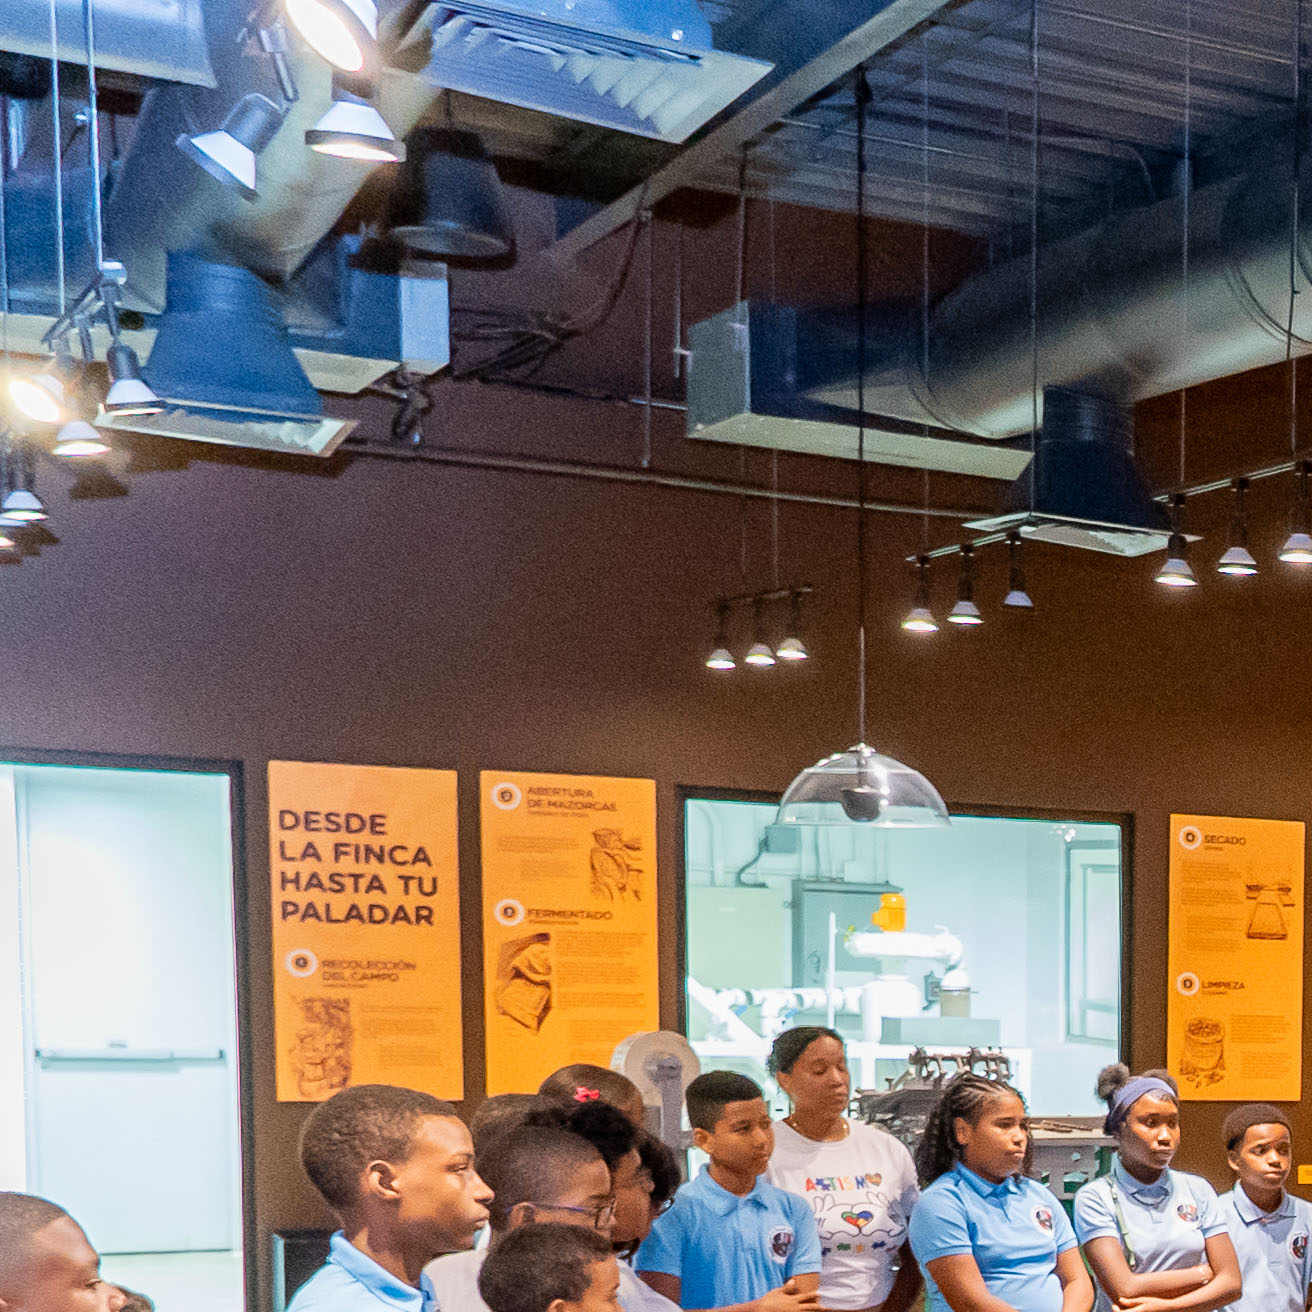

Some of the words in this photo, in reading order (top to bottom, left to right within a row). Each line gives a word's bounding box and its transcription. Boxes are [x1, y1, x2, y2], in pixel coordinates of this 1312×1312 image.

[279, 810, 387, 835] DESDE
[1205, 834, 1247, 846] SECADO
[279, 841, 322, 862] LA
[334, 843, 432, 867] FINCA
[280, 871, 387, 894] HASTA
[397, 875, 437, 897] TU
[281, 901, 434, 926] PALADAR
